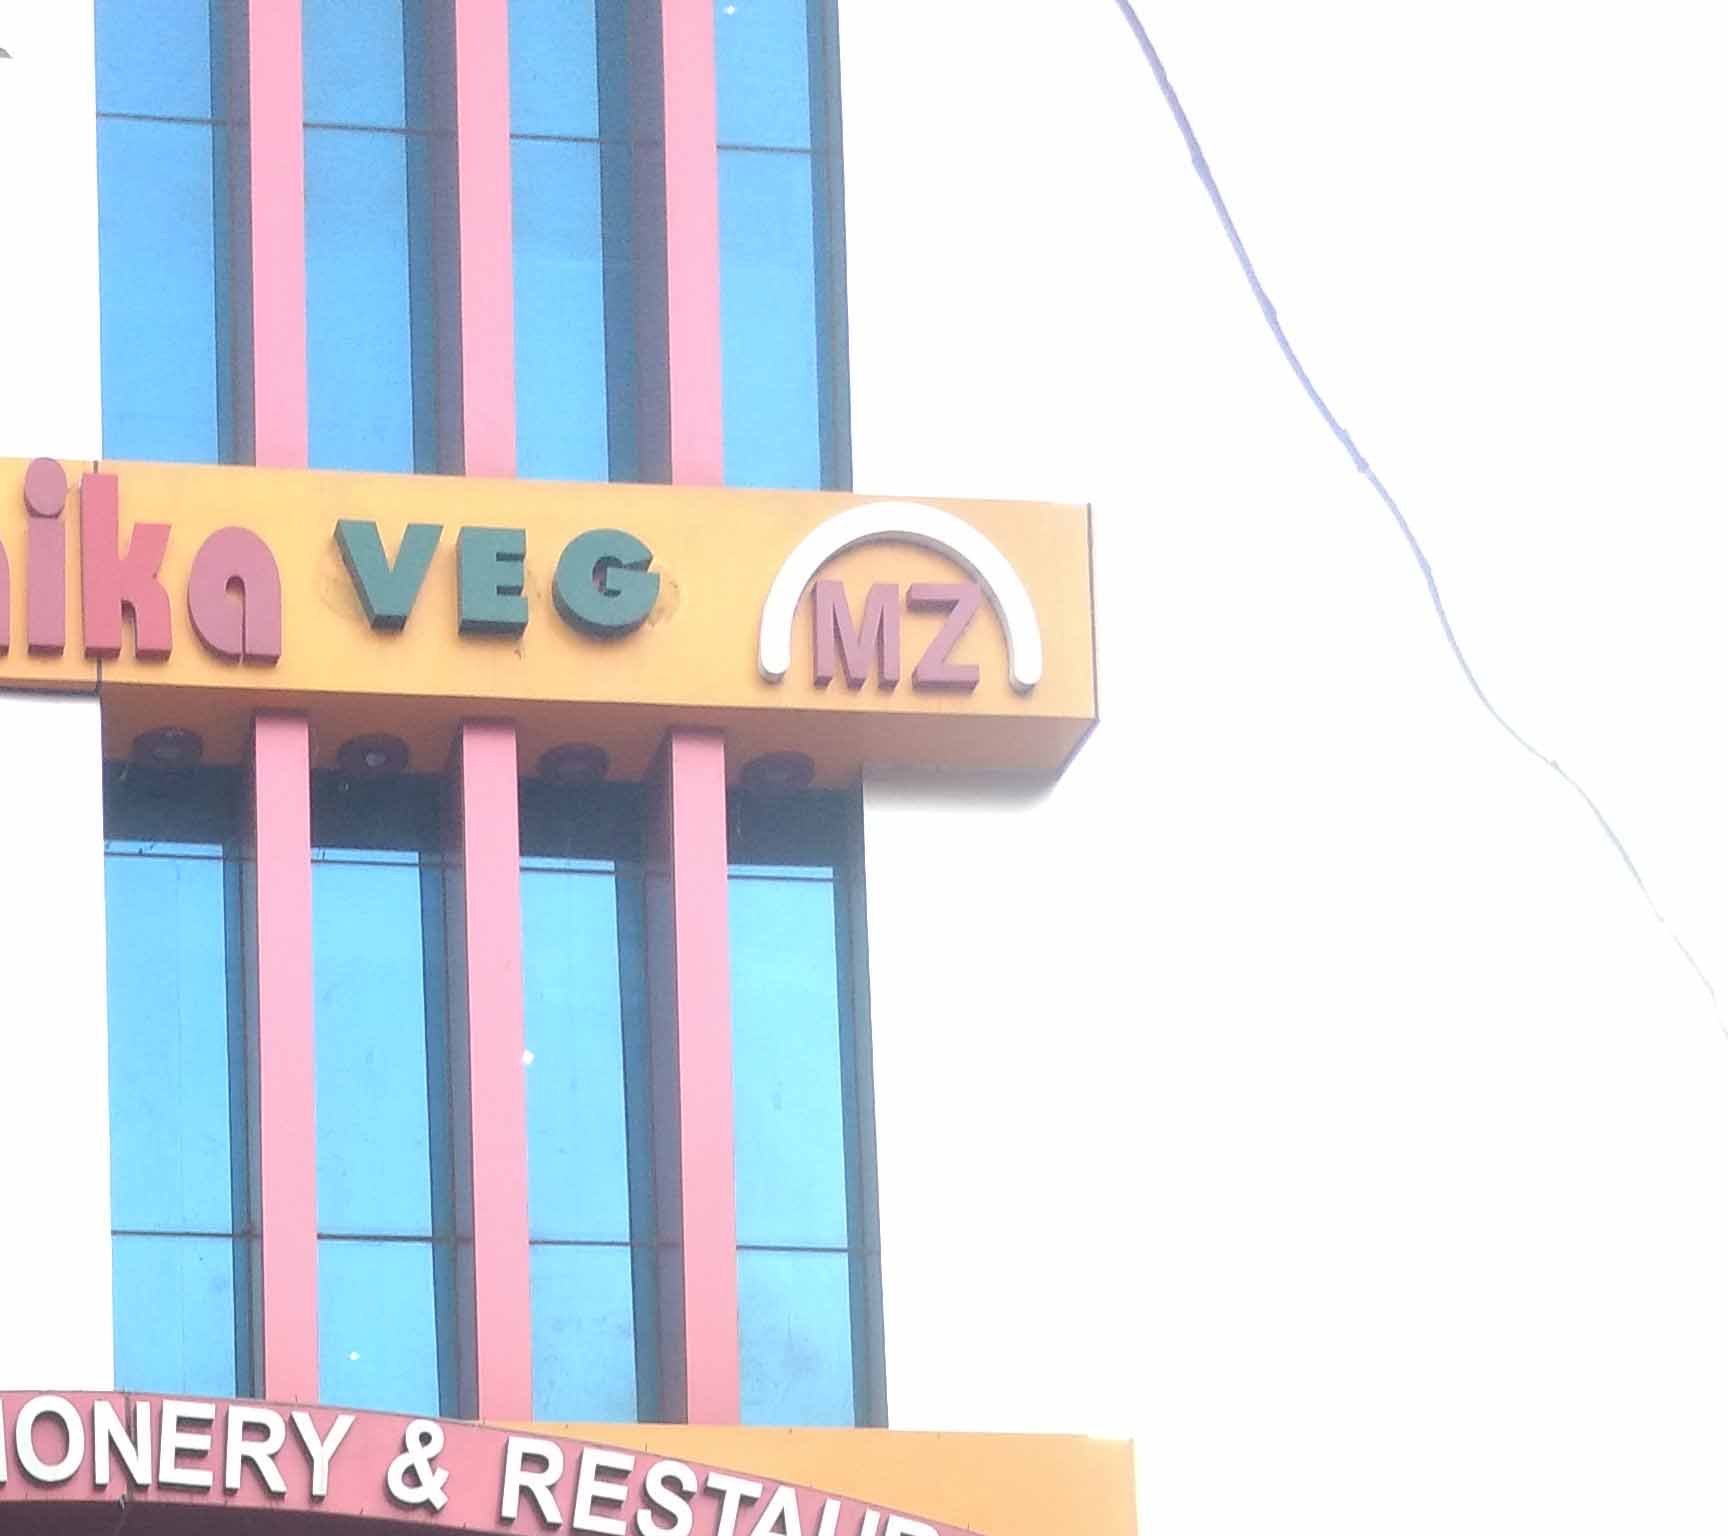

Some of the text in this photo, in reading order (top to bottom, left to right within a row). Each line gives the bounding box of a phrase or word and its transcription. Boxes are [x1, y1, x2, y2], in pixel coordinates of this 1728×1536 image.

[335, 519, 660, 640] VEG
[809, 578, 987, 692] MZ
[385, 1418, 450, 1511] &
